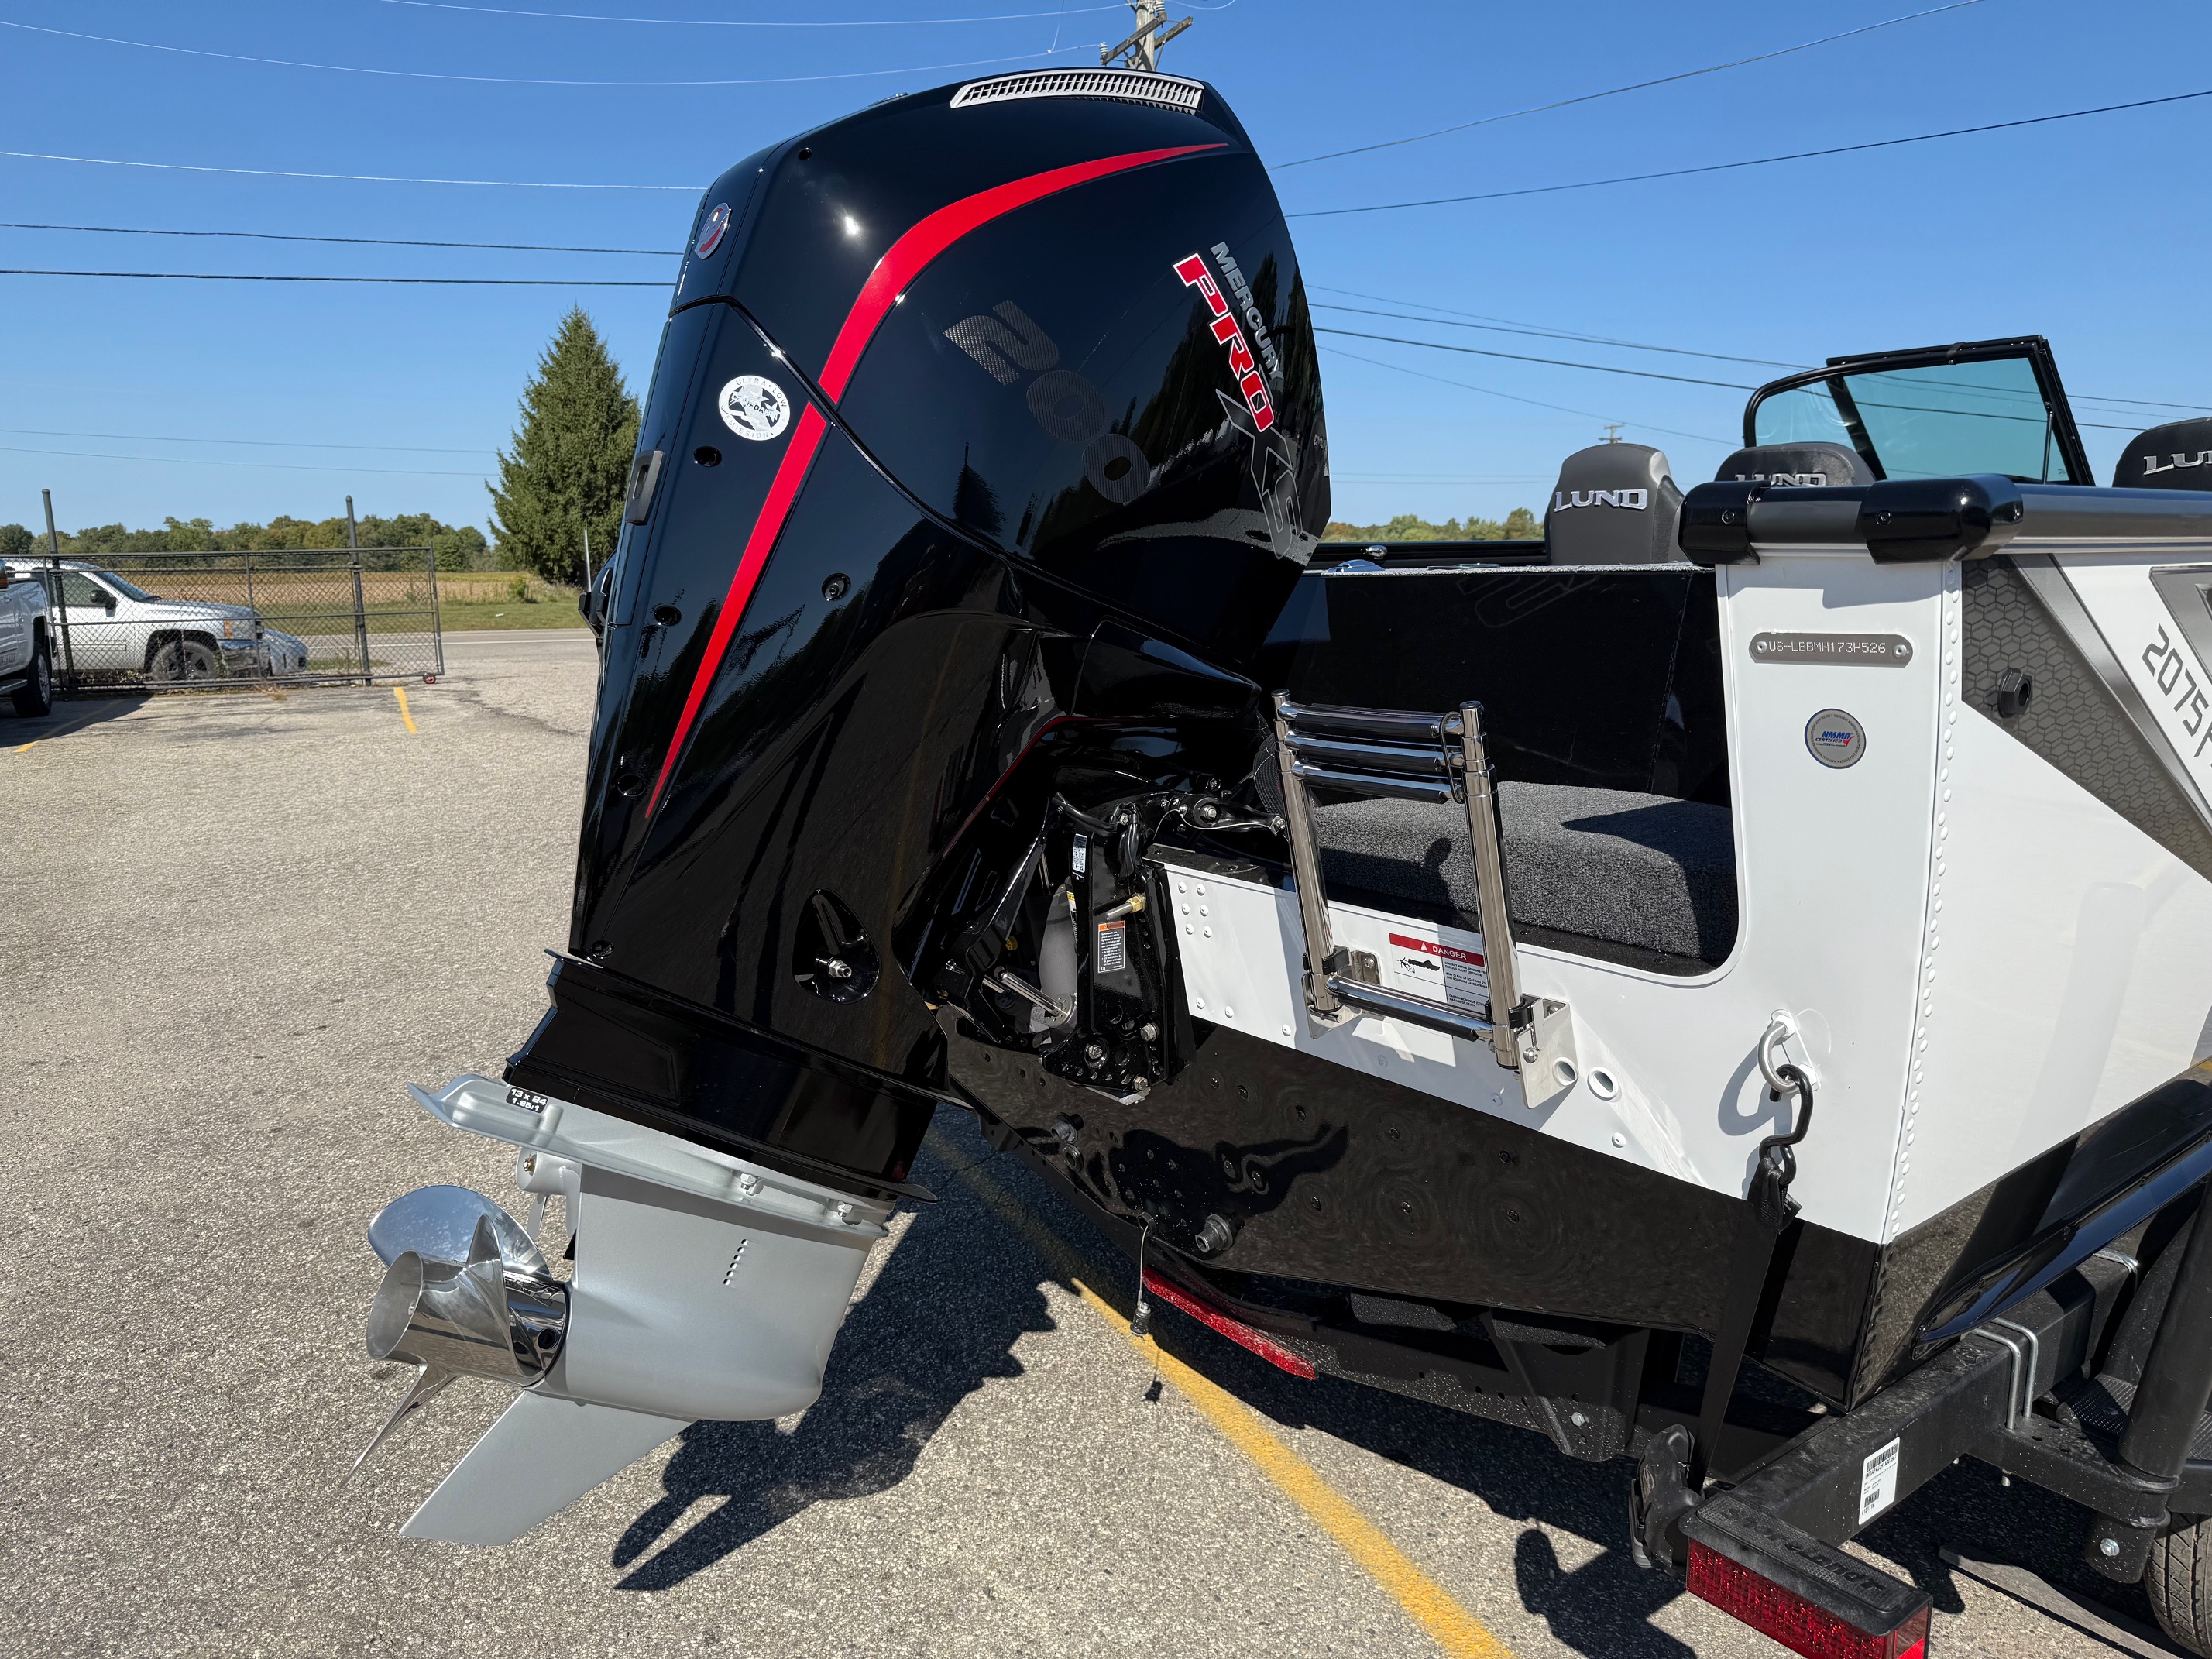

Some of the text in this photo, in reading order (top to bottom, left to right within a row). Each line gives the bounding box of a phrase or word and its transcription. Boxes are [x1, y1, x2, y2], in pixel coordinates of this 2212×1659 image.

[1210, 241, 1284, 380] MERCURY
[1172, 252, 1275, 433] PRO
[735, 377, 787, 407] ULTRA LOW
[943, 296, 1152, 504] 200
[725, 415, 768, 438] EMISSION
[1554, 489, 1647, 512] LUND
[1768, 641, 1887, 654] US-LBBMH173H526
[1822, 730, 1851, 740] NMMA
[1432, 946, 1467, 960] DANGER
[511, 1088, 524, 1097] 13
[531, 1095, 547, 1105] 24
[512, 1097, 540, 1111] 1.85:1
